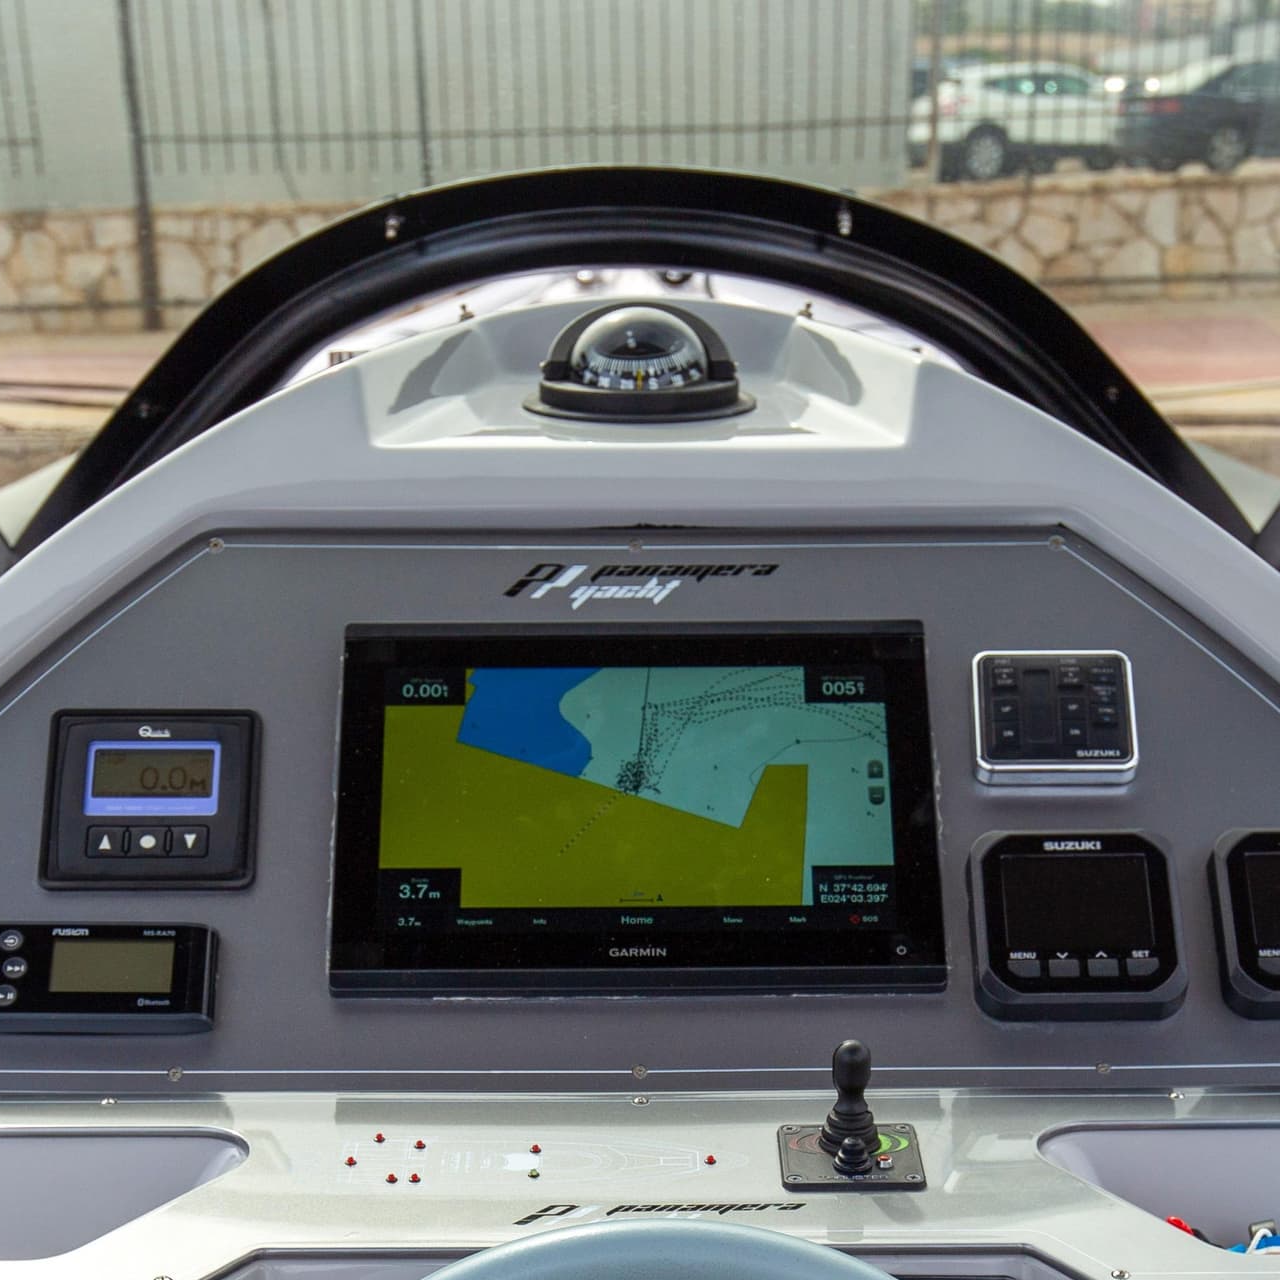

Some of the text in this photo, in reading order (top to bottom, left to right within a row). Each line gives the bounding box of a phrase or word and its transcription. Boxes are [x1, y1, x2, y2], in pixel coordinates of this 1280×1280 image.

[590, 563, 780, 582] panamera
[570, 577, 683, 610] yacht
[1076, 750, 1120, 758] SUZUKI
[1043, 841, 1102, 850] SUZUKI
[621, 915, 654, 925] Home
[608, 947, 667, 957] GARMIN
[1010, 952, 1037, 960] MENU
[1132, 950, 1150, 958] SET
[606, 1203, 807, 1216] panamera
